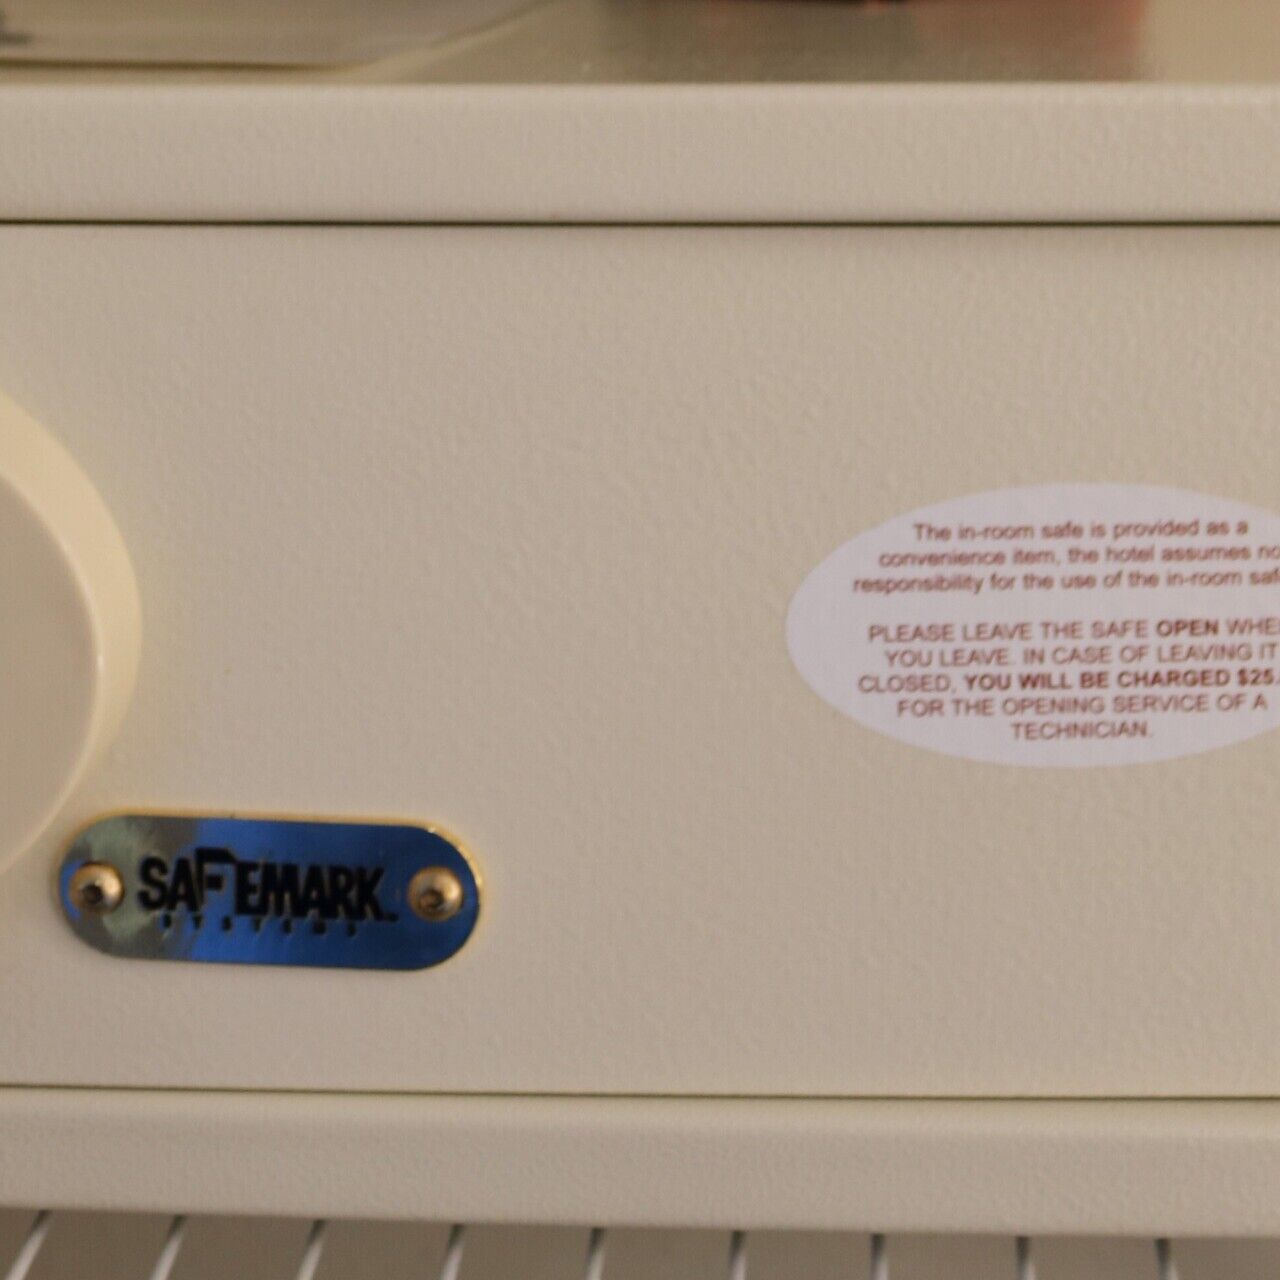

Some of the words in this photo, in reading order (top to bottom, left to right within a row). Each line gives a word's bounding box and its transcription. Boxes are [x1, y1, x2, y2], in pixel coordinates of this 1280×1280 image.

[914, 523, 952, 541] The
[958, 523, 1035, 540] in-room
[1041, 521, 1084, 539] safe
[1090, 521, 1107, 538] is
[1113, 519, 1200, 541] provided
[1206, 521, 1231, 536] as
[1236, 521, 1249, 536] a
[879, 550, 1006, 568] convenience
[1013, 548, 1061, 567] item,
[1068, 547, 1099, 564] the
[1105, 544, 1155, 562] hotel
[1161, 545, 1252, 561] assumes
[853, 574, 985, 595] responsibility
[989, 573, 1016, 590] for
[1022, 573, 1054, 590] the
[1062, 574, 1097, 589] use
[1103, 570, 1123, 588] of
[1128, 571, 1160, 588] the
[1167, 570, 1243, 587] in-room
[868, 623, 955, 642] PLEASE
[962, 622, 1032, 641] LEAVE
[1040, 621, 1083, 640] THE
[1091, 621, 1149, 638] SAFE
[1156, 619, 1219, 637] OPEN
[885, 649, 933, 668] YOU
[1023, 647, 1045, 665] IN
[1052, 646, 1112, 665] CASE
[1119, 645, 1149, 663] OF
[1157, 643, 1252, 663] LEAVING
[1259, 642, 1280, 660] IT
[858, 674, 957, 694] CLOSED,
[964, 673, 1012, 691] YOU
[1019, 672, 1072, 690] WILL
[1080, 671, 1109, 689] BE
[1117, 669, 1231, 688] CHARGED
[897, 699, 944, 718] FOR
[952, 698, 995, 717] THE
[1002, 696, 1105, 716] OPENING
[1113, 694, 1209, 714] SERVICE
[1217, 693, 1247, 712] OF
[1252, 693, 1268, 711] A
